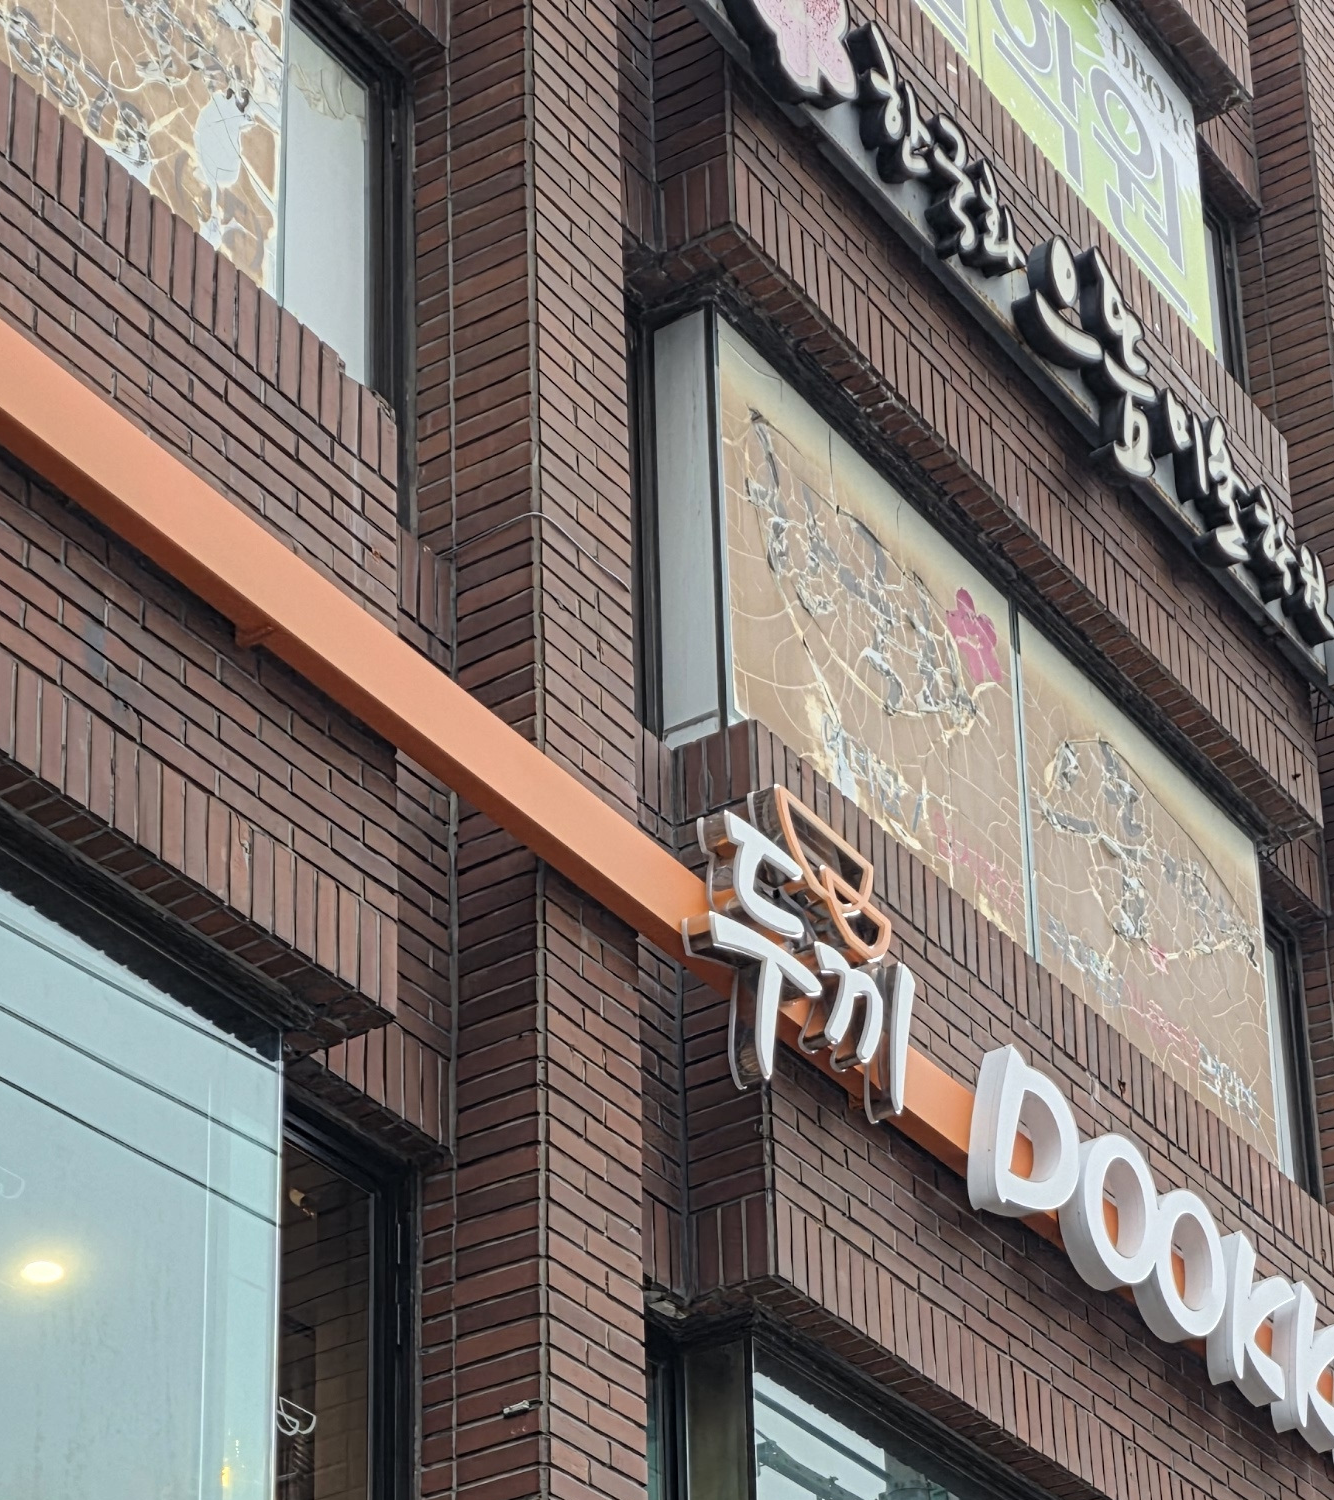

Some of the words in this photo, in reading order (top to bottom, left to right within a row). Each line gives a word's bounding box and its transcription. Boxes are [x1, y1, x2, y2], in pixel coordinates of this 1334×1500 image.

[865, 20, 1027, 270] 한국화
[1029, 234, 1159, 478] 으뜸
[703, 808, 916, 1116] 두끼
